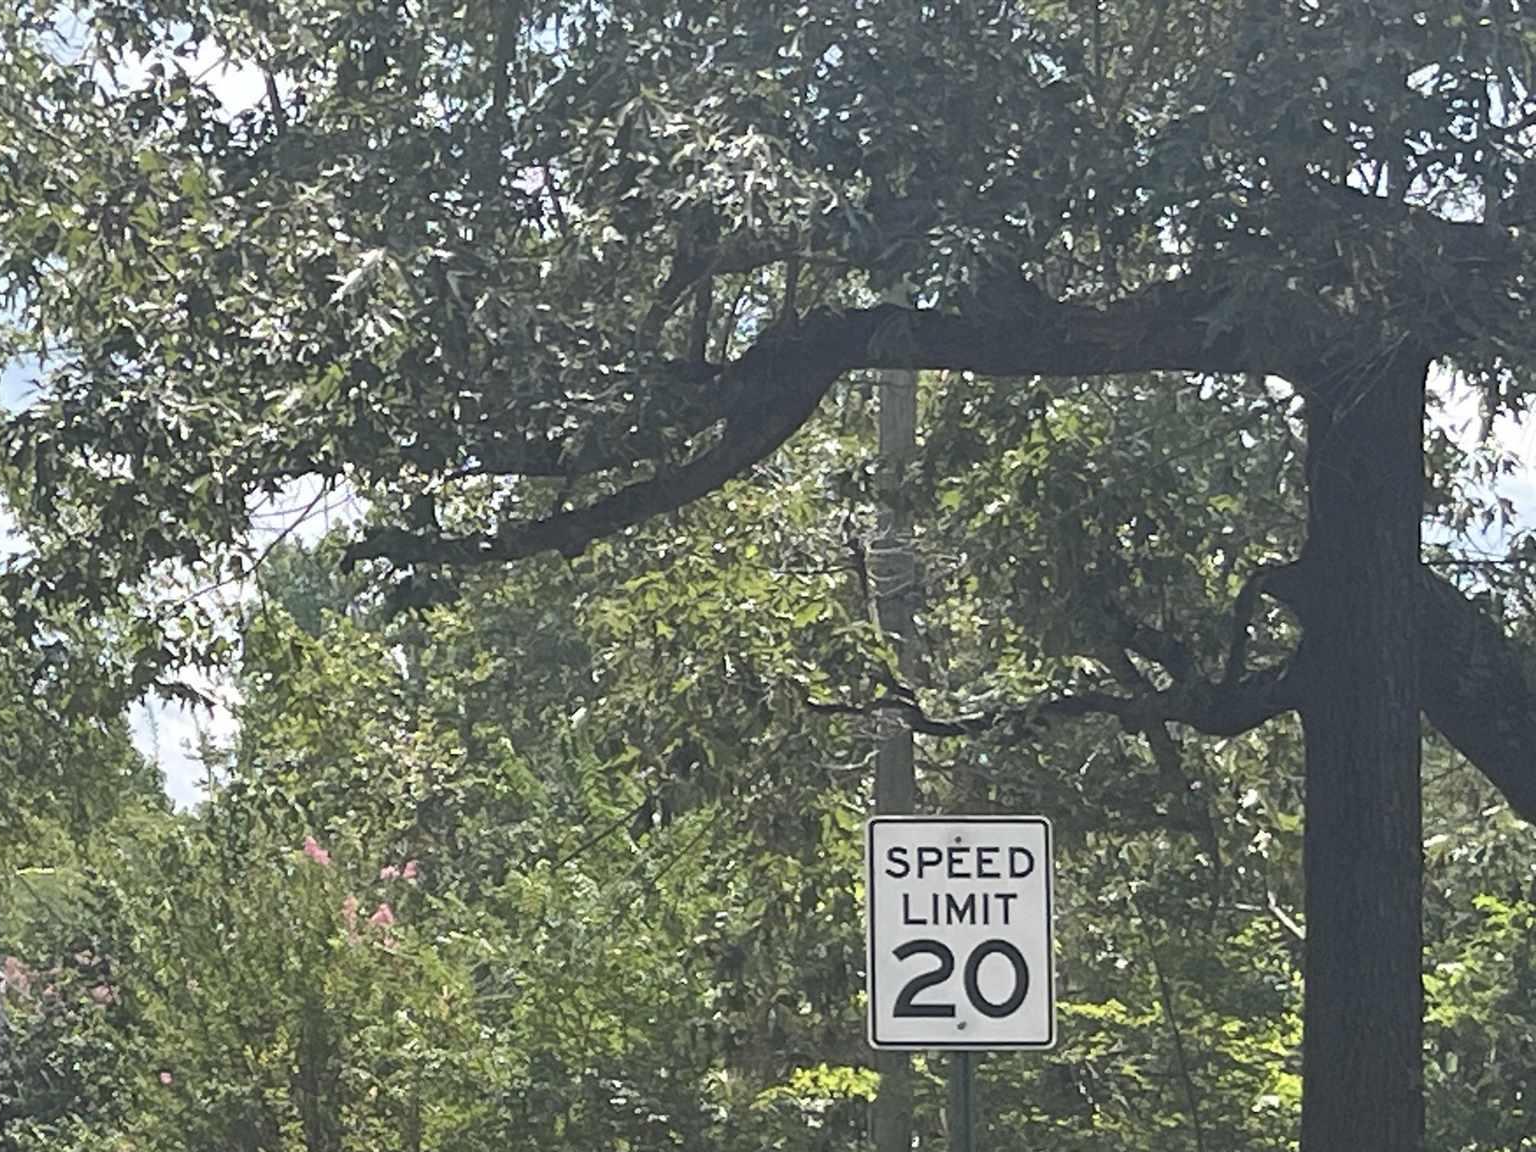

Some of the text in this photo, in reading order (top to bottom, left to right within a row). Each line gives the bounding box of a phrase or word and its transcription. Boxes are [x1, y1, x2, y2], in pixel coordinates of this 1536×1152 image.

[885, 846, 1035, 879] SPEED
[902, 893, 1018, 925] LIMIT
[892, 939, 1030, 1019] 20
